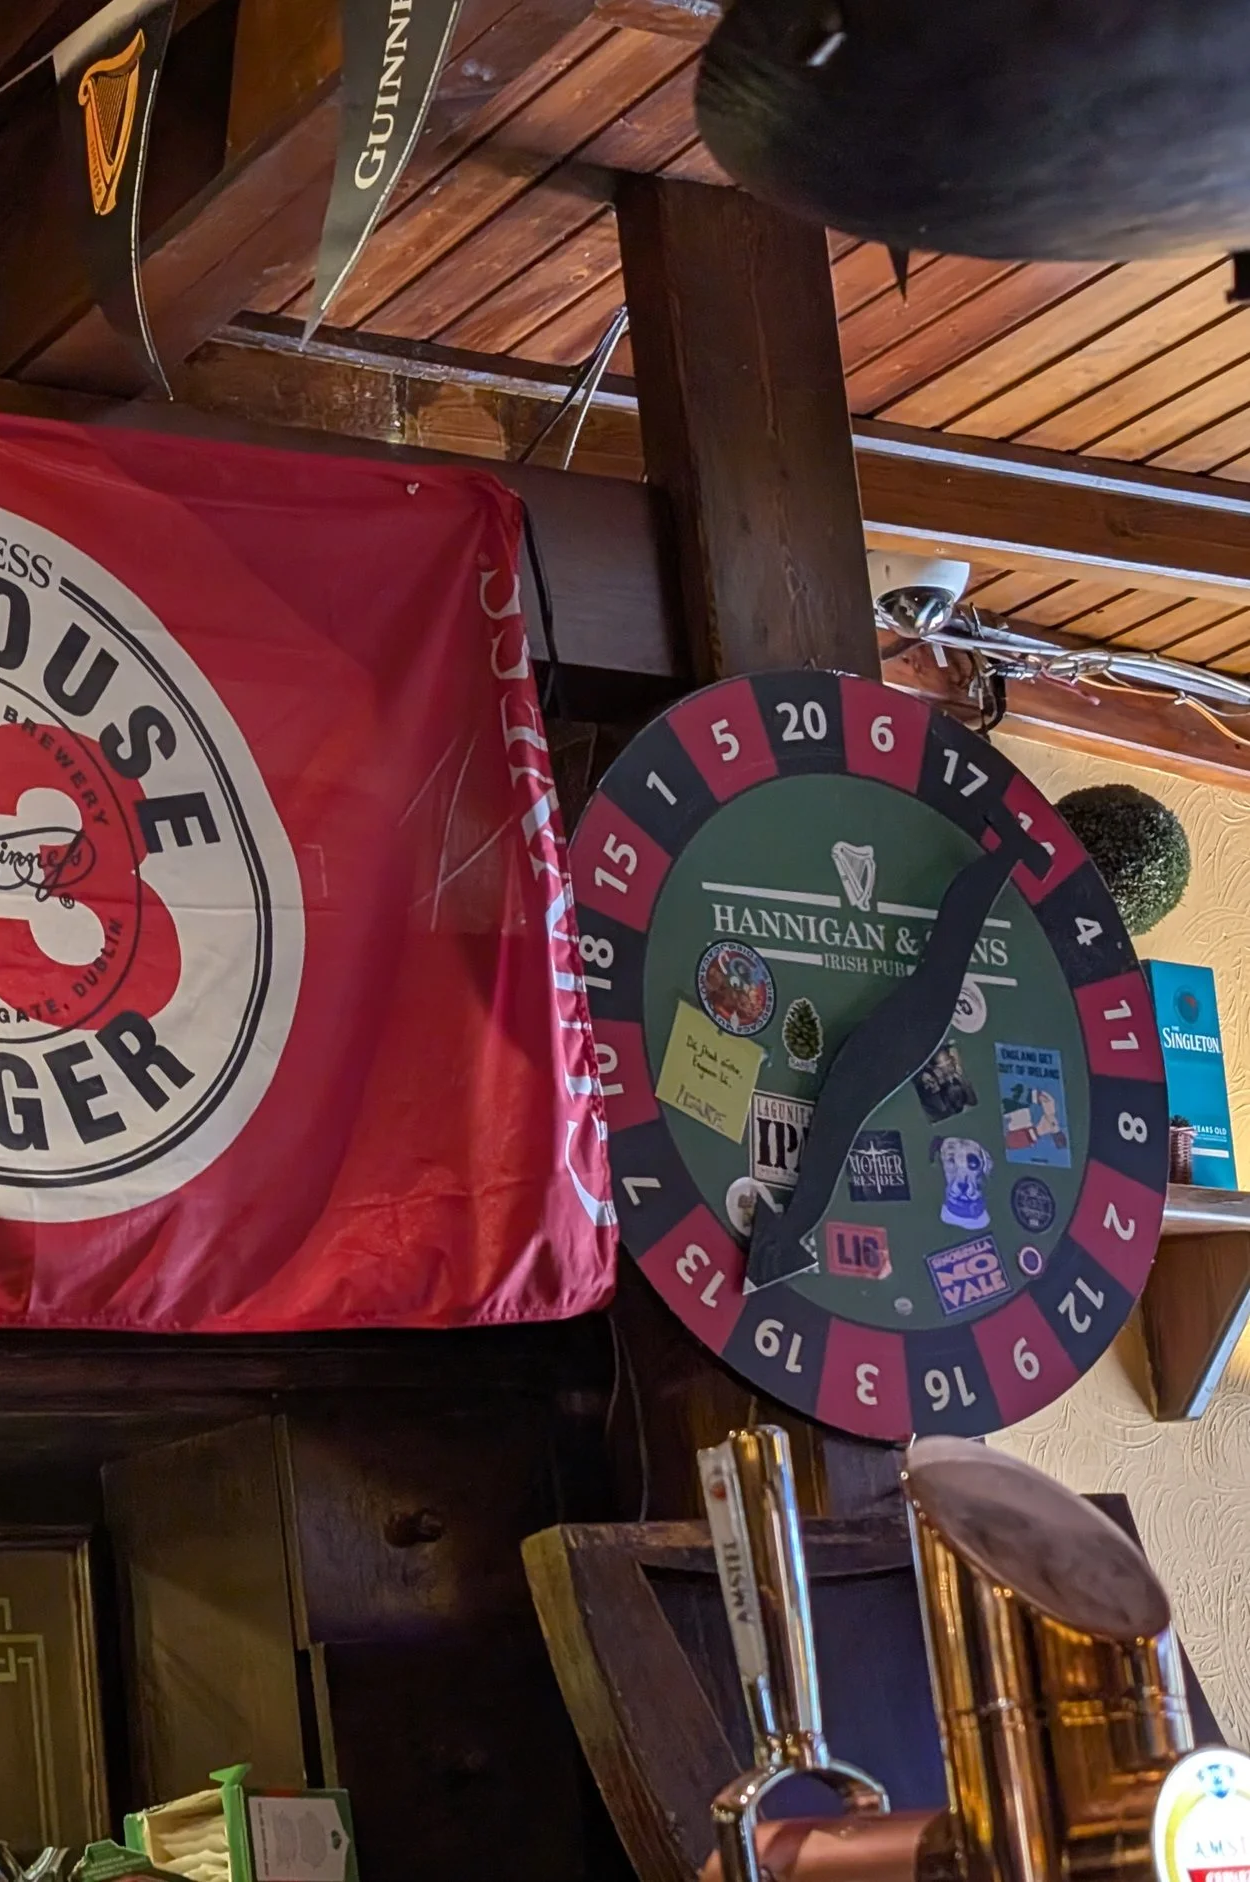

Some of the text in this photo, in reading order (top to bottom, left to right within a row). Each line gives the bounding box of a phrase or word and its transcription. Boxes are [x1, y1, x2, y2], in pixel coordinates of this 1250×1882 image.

[711, 719, 741, 763] 5
[775, 702, 828, 744] 20
[869, 716, 895, 754] 6
[3, 703, 111, 828] BREWERY
[940, 749, 989, 798] 17
[645, 771, 678, 806] 1
[594, 833, 639, 894] 15
[711, 903, 886, 952] HANNIGAN
[895, 926, 919, 956] &
[1074, 914, 1103, 946] 4
[72, 918, 124, 1000] DUBLIN
[578, 934, 616, 990] 18
[822, 953, 906, 978] IRISH PUB
[1102, 998, 1140, 1053] 11
[1162, 1028, 1222, 1054] SINGLETON
[1117, 1111, 1148, 1145] 8
[1215, 1125, 1227, 1136] OLD
[622, 1175, 662, 1204] 7
[1103, 1204, 1137, 1240] 2
[675, 1243, 720, 1309] 13
[1057, 1276, 1106, 1335] 12
[753, 1319, 804, 1372] 19
[1012, 1337, 1041, 1381] 9
[855, 1363, 879, 1405] 3
[923, 1364, 977, 1409] 16
